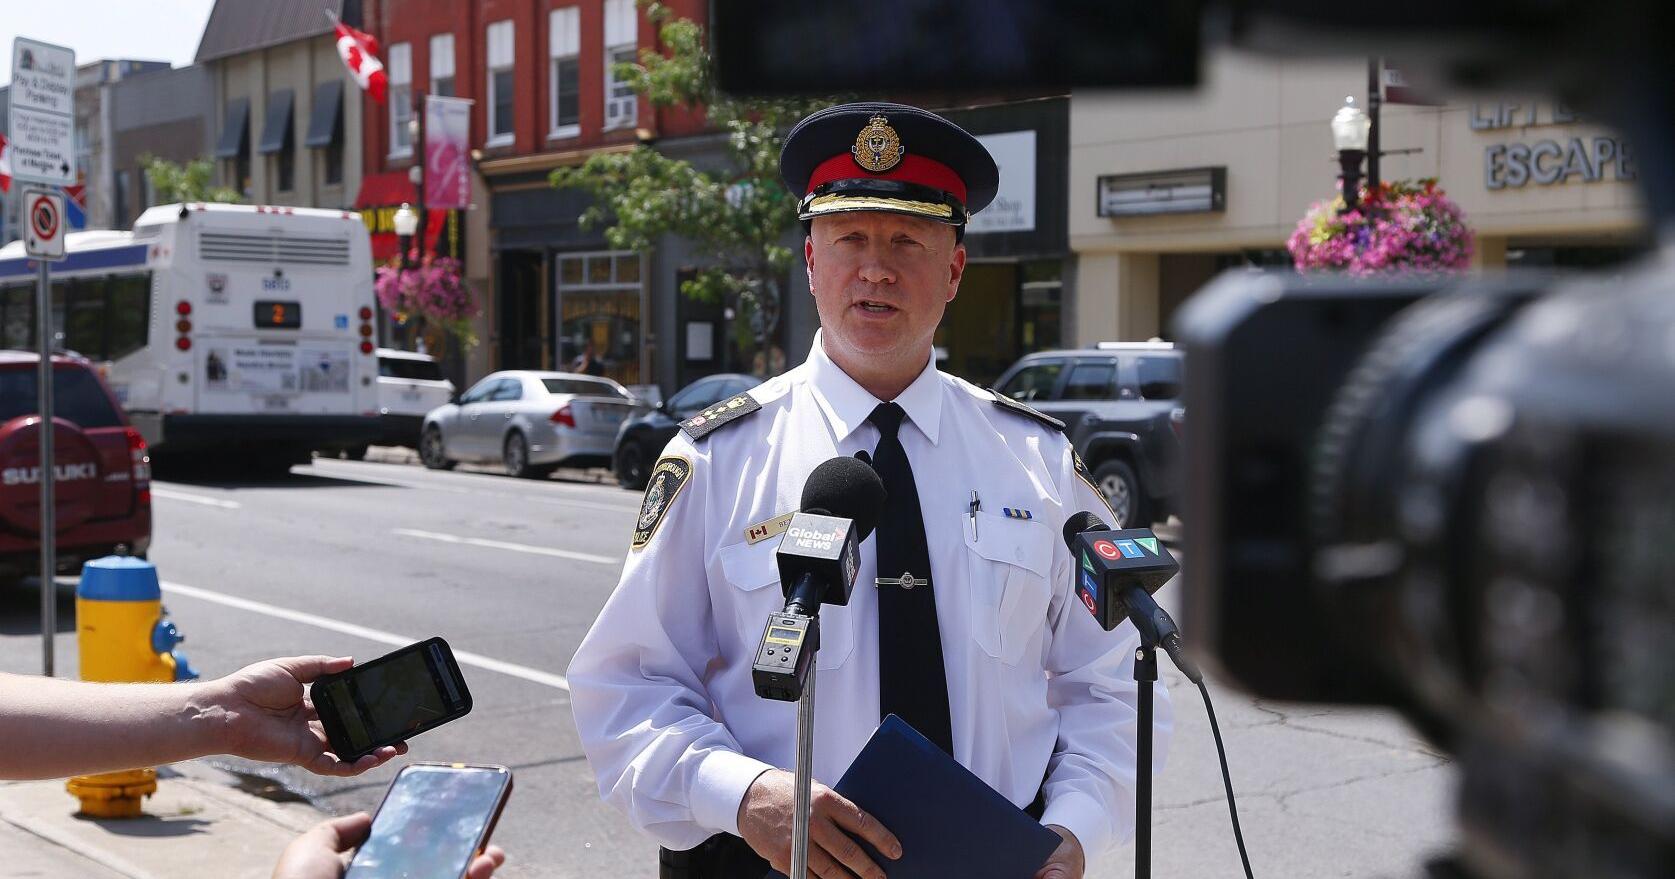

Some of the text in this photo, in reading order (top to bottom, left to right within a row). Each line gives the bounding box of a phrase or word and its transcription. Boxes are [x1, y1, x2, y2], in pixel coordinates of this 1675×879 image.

[1486, 137, 1637, 190] ESCAPE
[271, 303, 285, 324] 2
[2, 463, 97, 485] SUUKI
[789, 527, 836, 541] Global
[796, 538, 832, 551] NEWS
[1094, 537, 1160, 560] CTV
[1082, 548, 1097, 615] CTV
